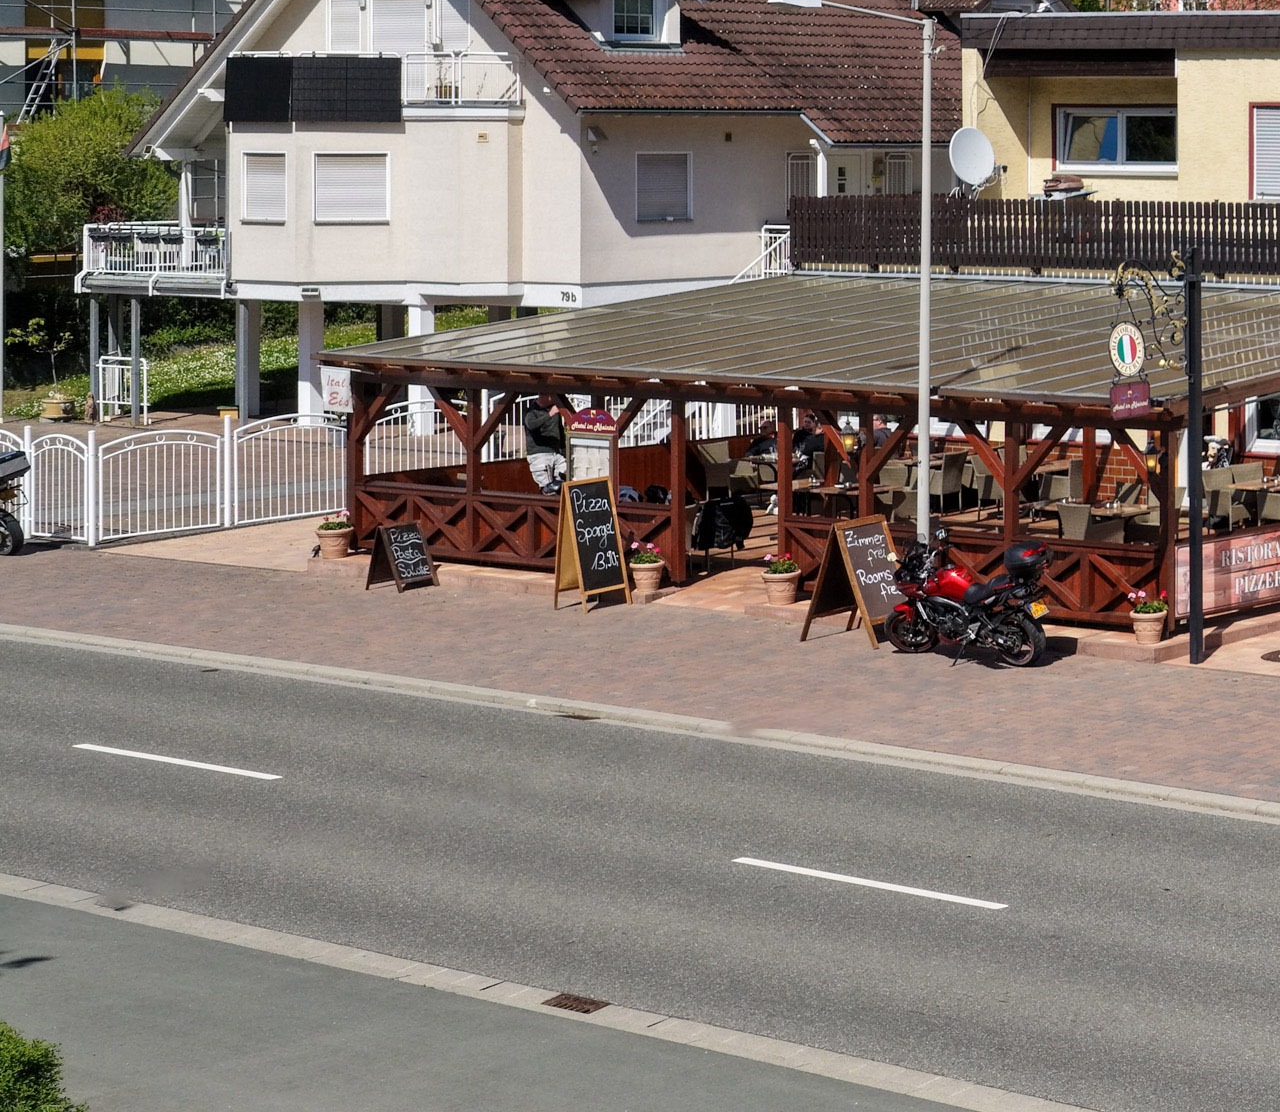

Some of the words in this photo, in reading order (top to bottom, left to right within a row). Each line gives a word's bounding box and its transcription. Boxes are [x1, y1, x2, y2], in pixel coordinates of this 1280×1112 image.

[328, 391, 350, 407] Eis
[570, 488, 611, 514] Pizza
[389, 528, 422, 543] Pizza
[576, 517, 615, 549] Spargel
[844, 530, 885, 548] Zimmer
[391, 546, 426, 560] Pasta
[397, 560, 431, 578] Salate
[856, 569, 894, 586] Rooms
